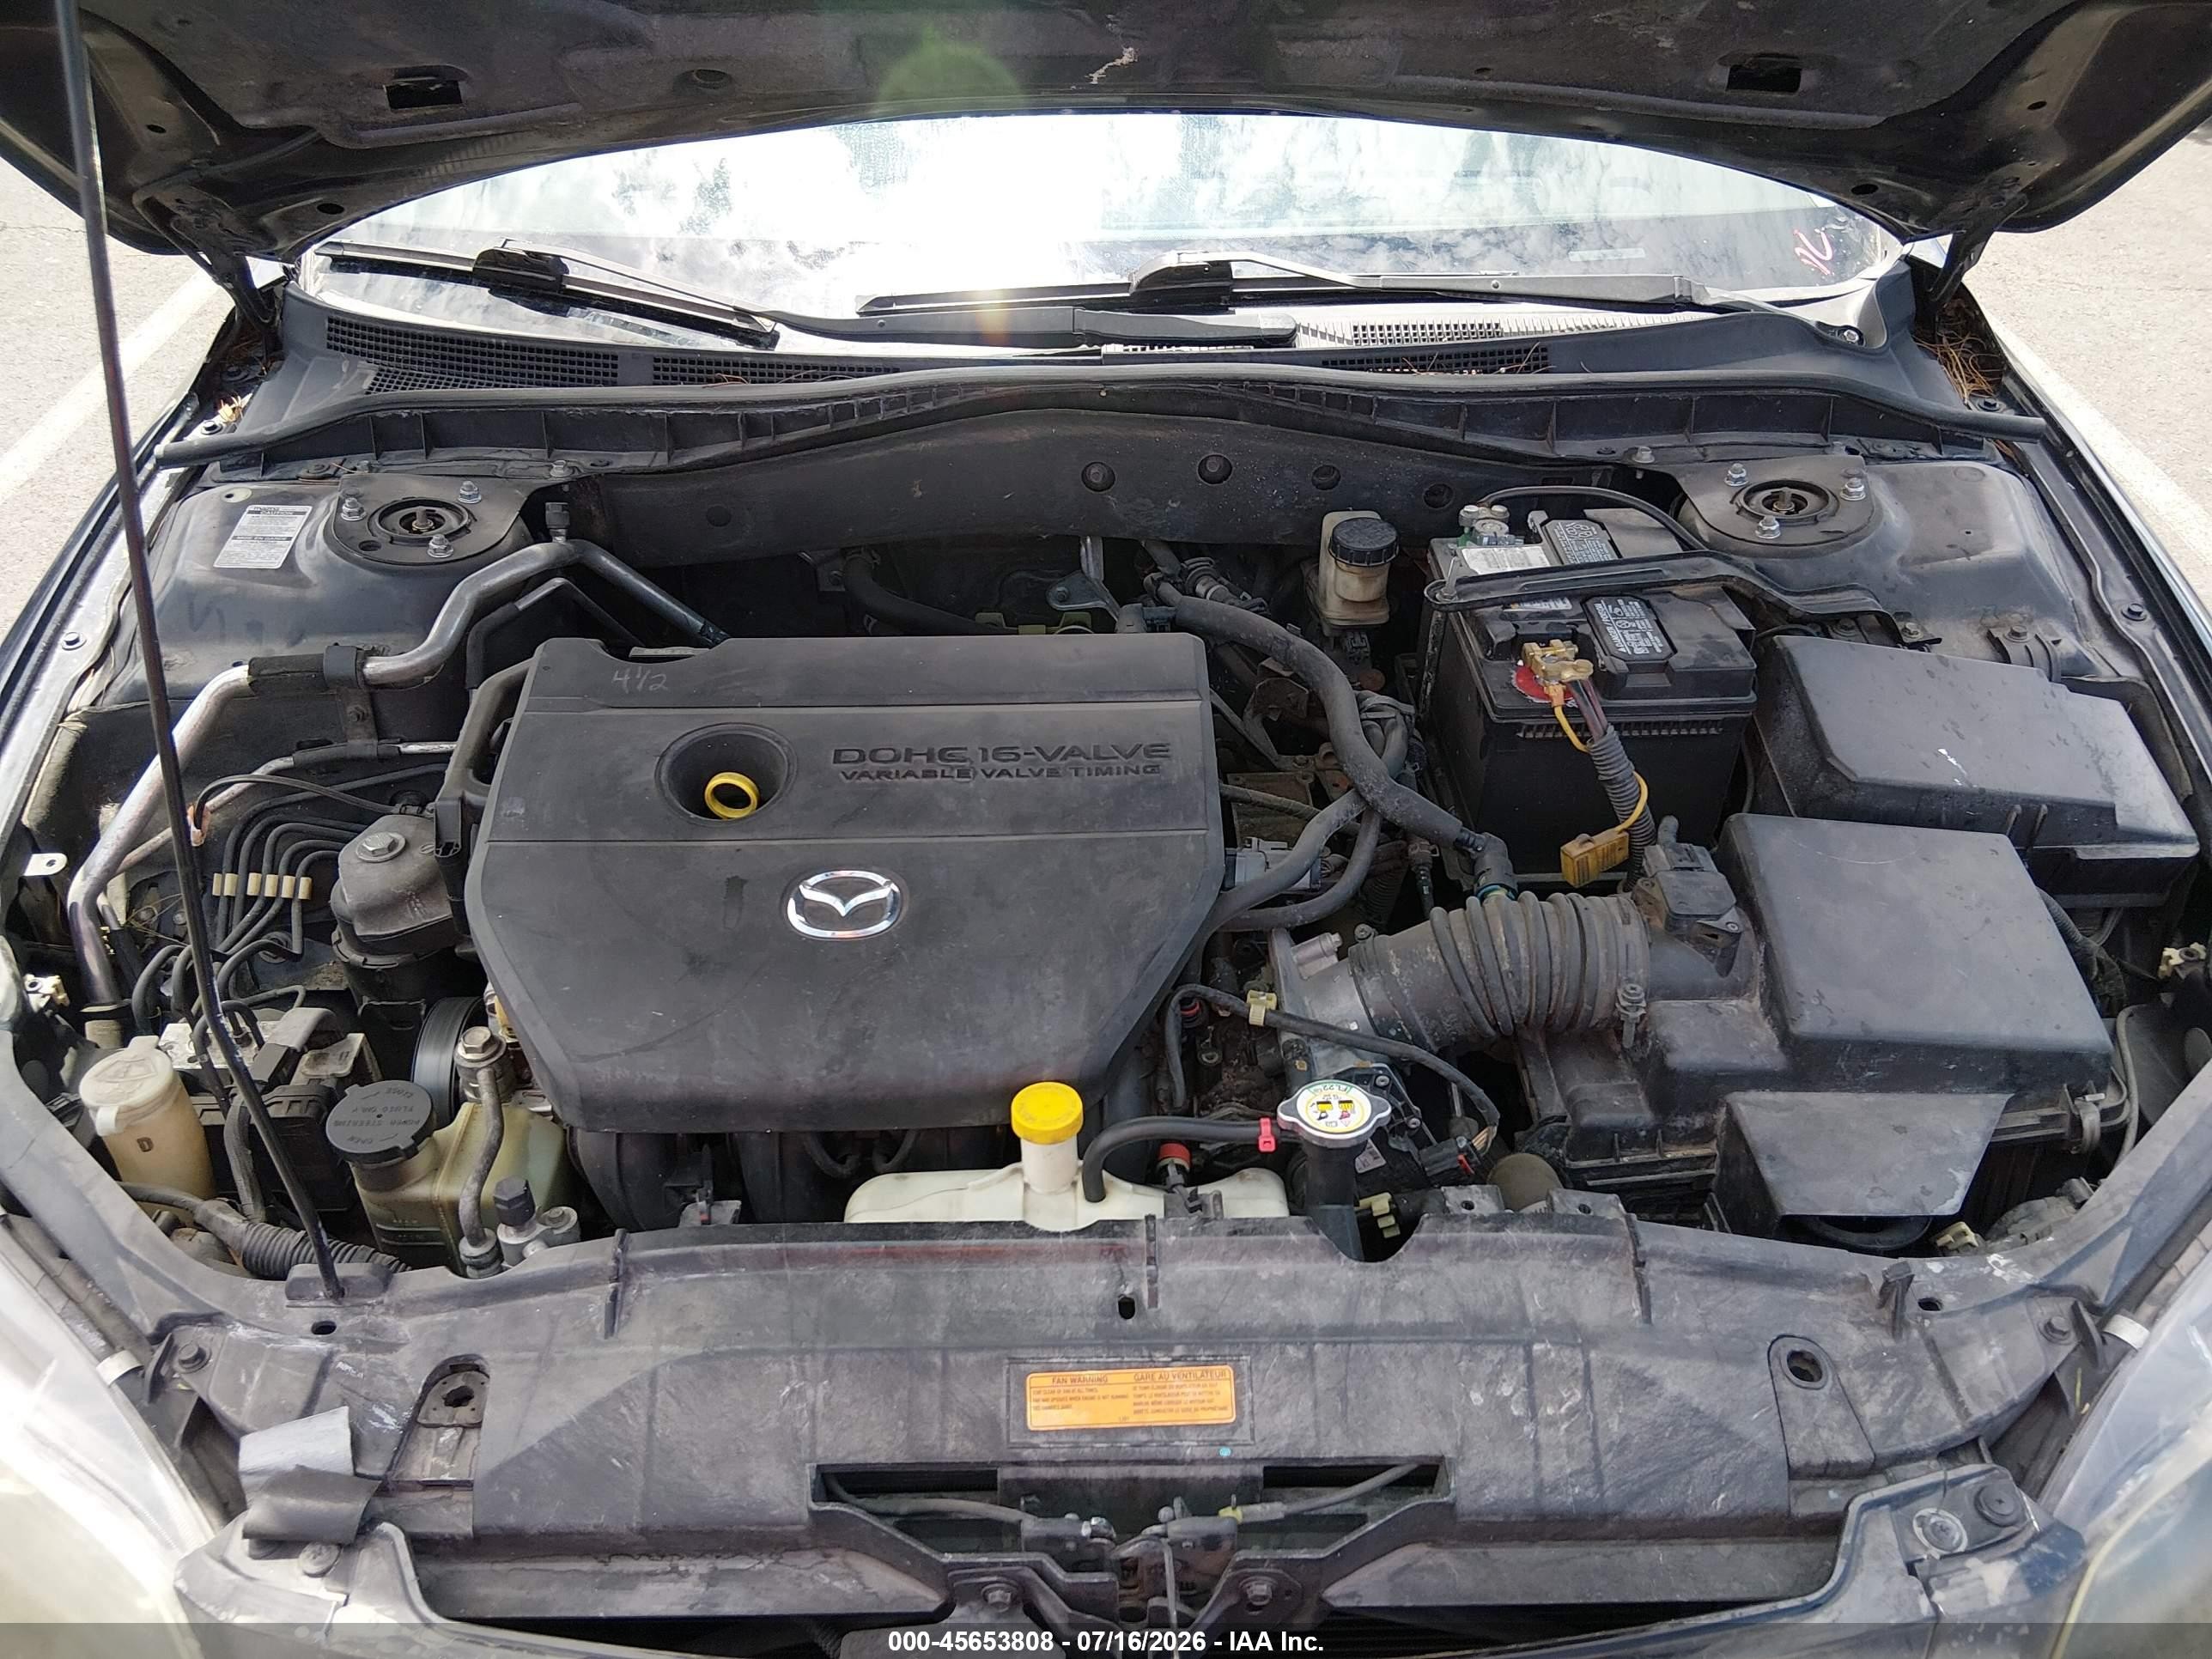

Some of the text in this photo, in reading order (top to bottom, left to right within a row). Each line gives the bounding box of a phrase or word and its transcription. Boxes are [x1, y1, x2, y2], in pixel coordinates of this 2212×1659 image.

[832, 742, 1171, 765] DOHC 16-VALVE
[841, 764, 1162, 781] VARIABLE VALVE TIMING
[382, 1105, 414, 1114] FLUID
[333, 1119, 382, 1127] STEERING
[1051, 1374, 1109, 1384] FAN WARNING
[1133, 1369, 1227, 1382] GARE AU VENTILATEUR
